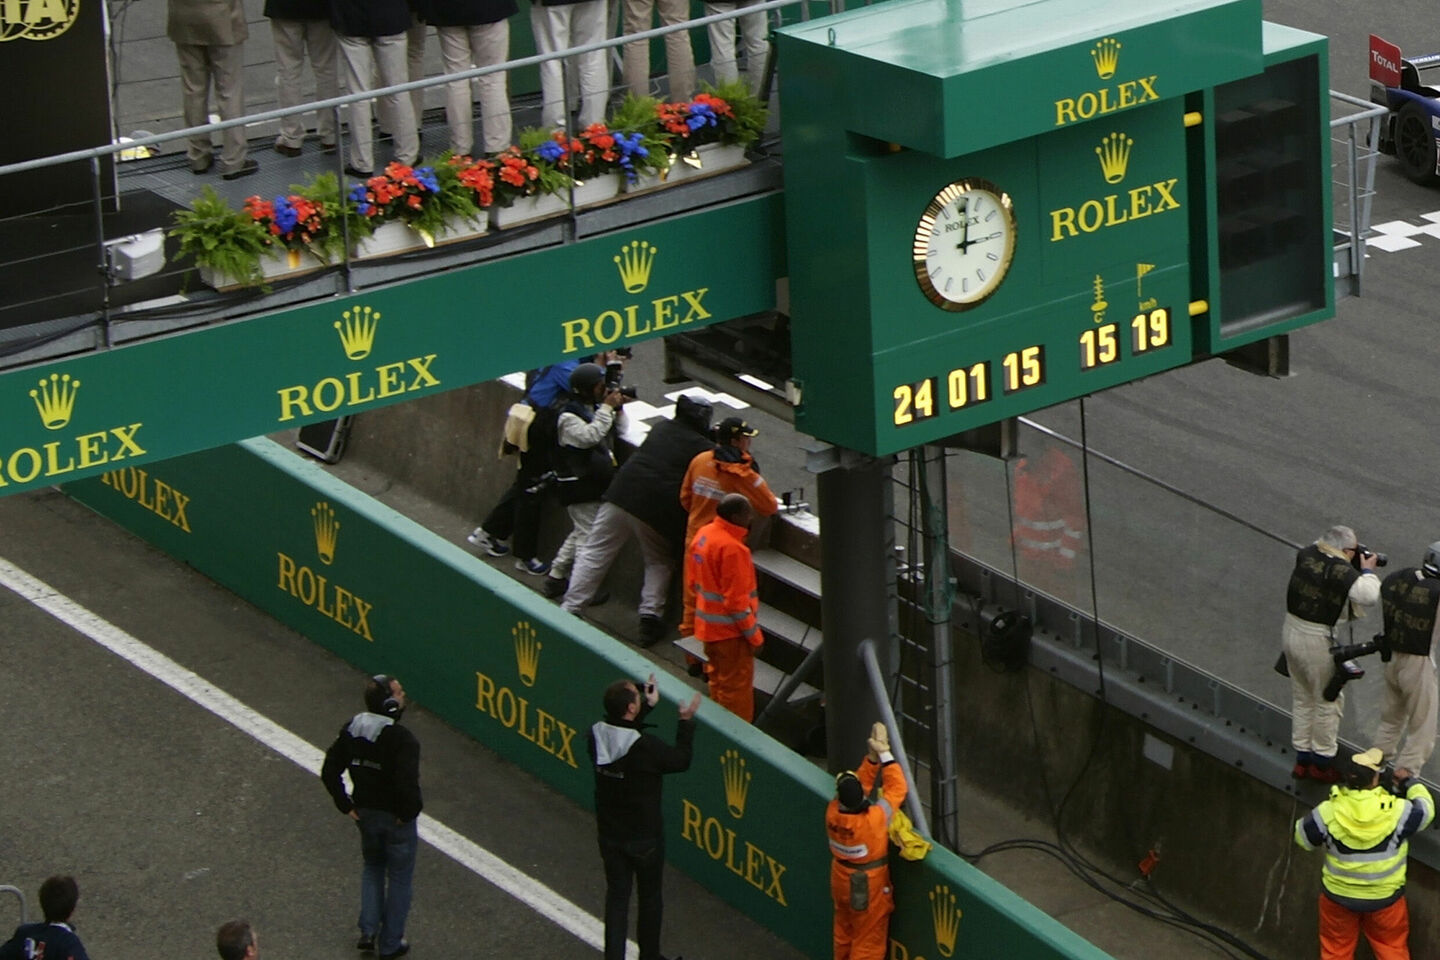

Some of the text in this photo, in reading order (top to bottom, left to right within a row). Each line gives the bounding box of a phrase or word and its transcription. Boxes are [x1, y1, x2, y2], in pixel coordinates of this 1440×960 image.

[1372, 50, 1399, 74] TOTAL
[1055, 76, 1160, 127] ROLEX
[945, 215, 980, 233] ROLEX
[1050, 178, 1181, 242] ROLEX
[561, 287, 713, 354] ROLEX
[1080, 323, 1117, 368] 15
[1132, 308, 1168, 351] 19
[277, 353, 441, 423] ROLEX
[893, 346, 1041, 425] 24 01 15
[0, 423, 147, 488] OLEX
[277, 551, 374, 642] ROLEX
[475, 671, 579, 769] ROLEX
[681, 799, 788, 908] ROLEX
